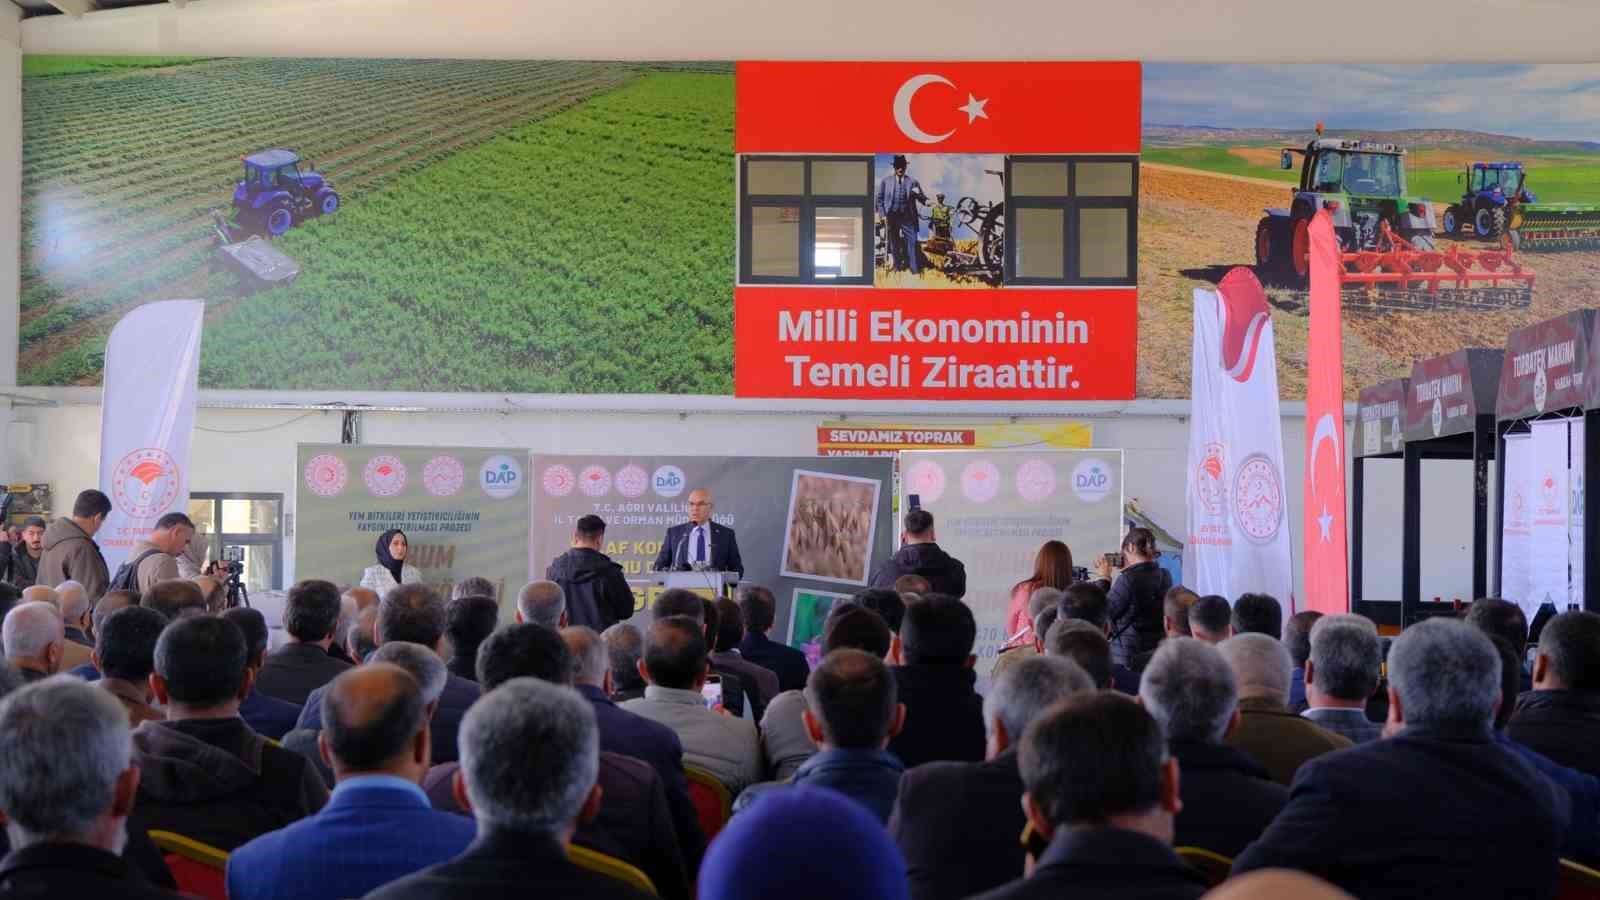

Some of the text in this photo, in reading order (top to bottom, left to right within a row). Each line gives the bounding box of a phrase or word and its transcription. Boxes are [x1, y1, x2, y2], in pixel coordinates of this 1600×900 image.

[778, 309, 1089, 344] Milli Ekonominin
[785, 355, 1081, 390] Temeli Ziraattir.
[830, 430, 963, 443] SEVDAMIZ TOPRAK
[486, 470, 516, 484] DAP
[656, 476, 681, 487] DAP
[1076, 474, 1107, 488] DAP
